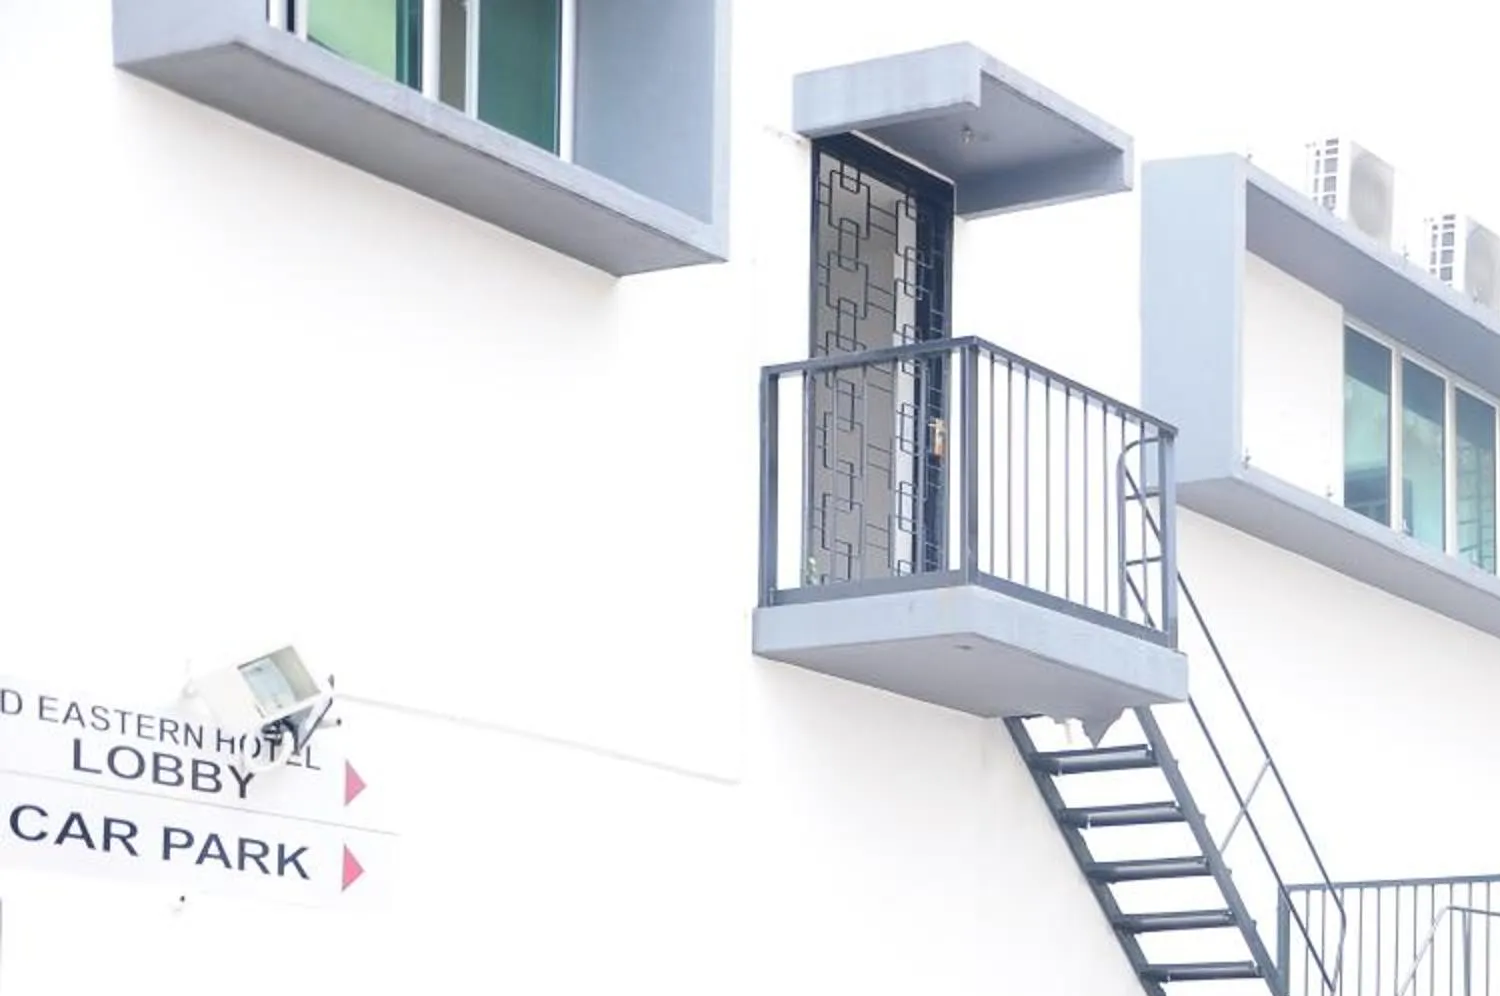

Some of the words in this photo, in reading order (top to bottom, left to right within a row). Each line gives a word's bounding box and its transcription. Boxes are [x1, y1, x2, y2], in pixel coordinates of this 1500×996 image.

[38, 695, 203, 750] EASTERN
[72, 738, 254, 799] LOBBY
[9, 804, 139, 857] CAR
[162, 826, 310, 880] PARK
